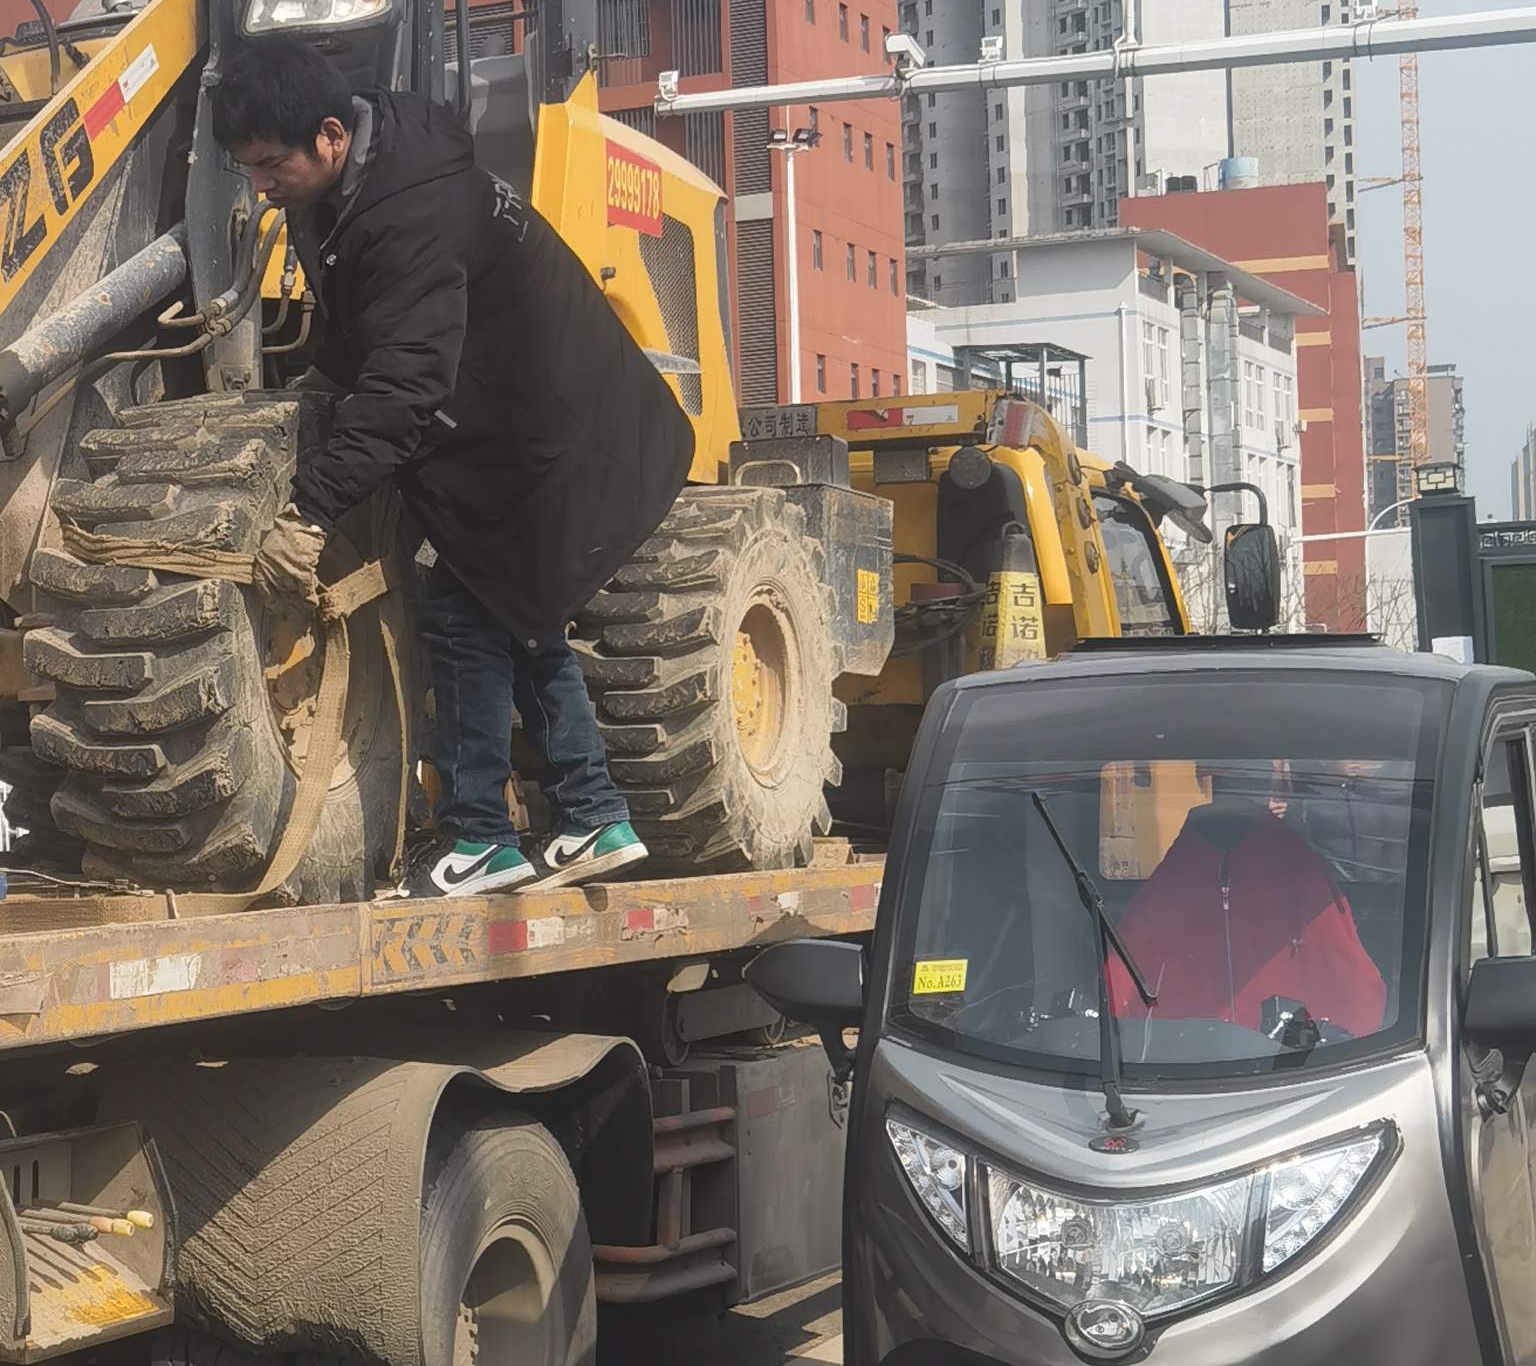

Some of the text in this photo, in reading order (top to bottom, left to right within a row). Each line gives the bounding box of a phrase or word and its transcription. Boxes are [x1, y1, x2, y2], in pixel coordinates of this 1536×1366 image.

[607, 156, 661, 220] 29999178
[747, 411, 810, 437] 公司制造
